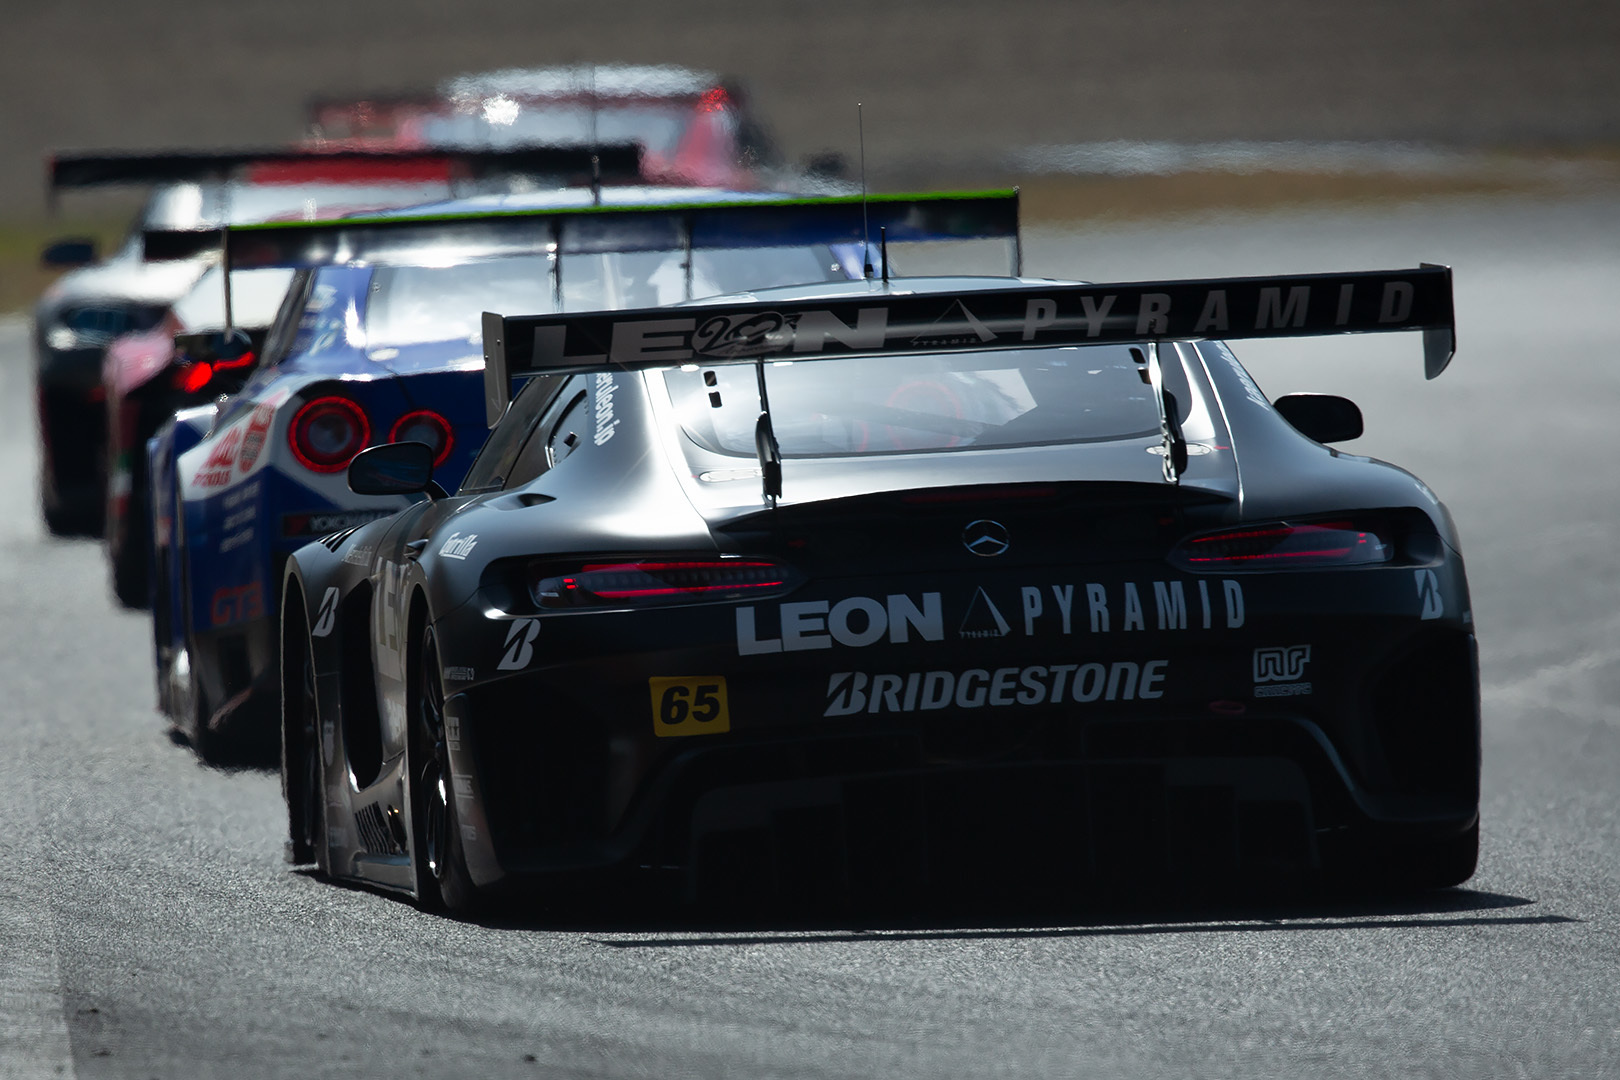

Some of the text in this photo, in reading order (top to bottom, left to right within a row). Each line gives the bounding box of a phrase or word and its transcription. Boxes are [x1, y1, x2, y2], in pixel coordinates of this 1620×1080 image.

[1022, 281, 1415, 341] PYRAMID
[735, 579, 1246, 656] LEON PYRAMID
[659, 684, 721, 726] 65
[823, 660, 1169, 717] BRIDGESTONE
